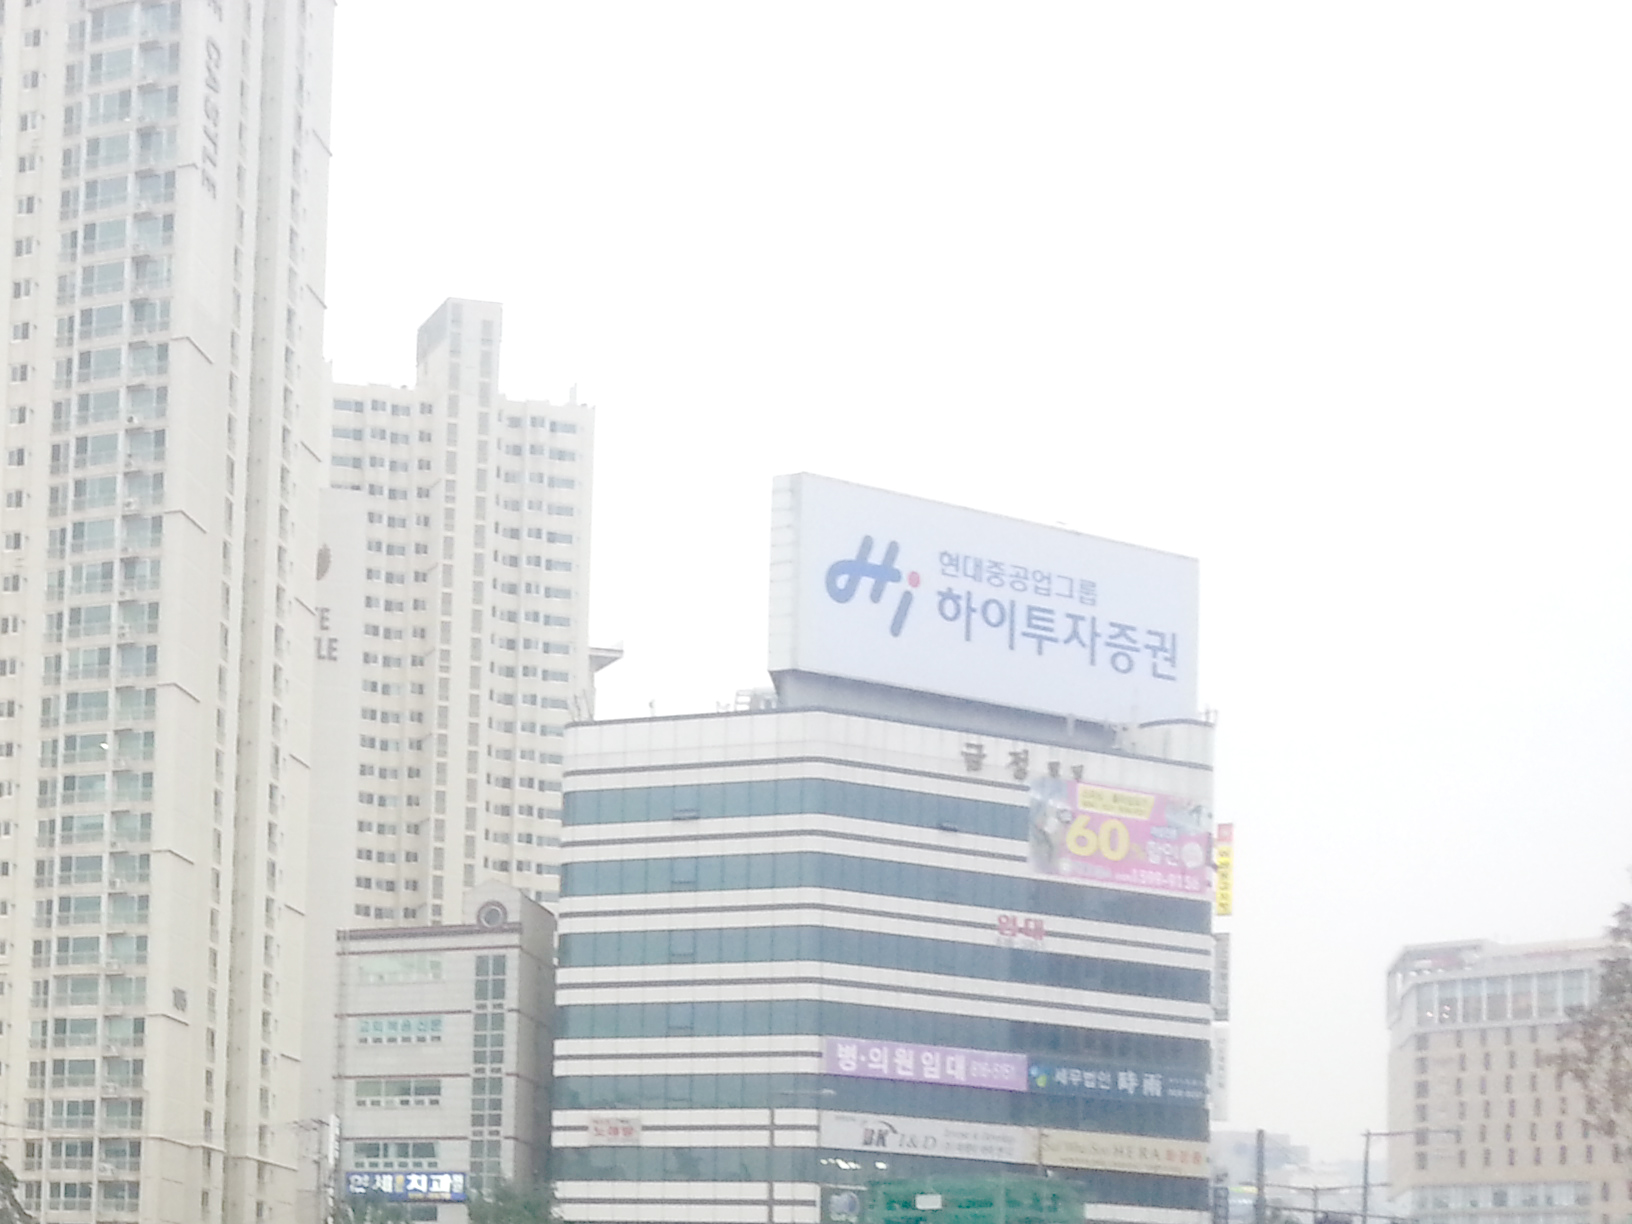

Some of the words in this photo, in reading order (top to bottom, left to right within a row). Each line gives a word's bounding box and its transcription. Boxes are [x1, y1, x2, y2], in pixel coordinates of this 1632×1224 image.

[938, 550, 1098, 606] 현대중공업그룹
[936, 586, 1179, 682] 하이투자증권
[997, 913, 1046, 941] 임대
